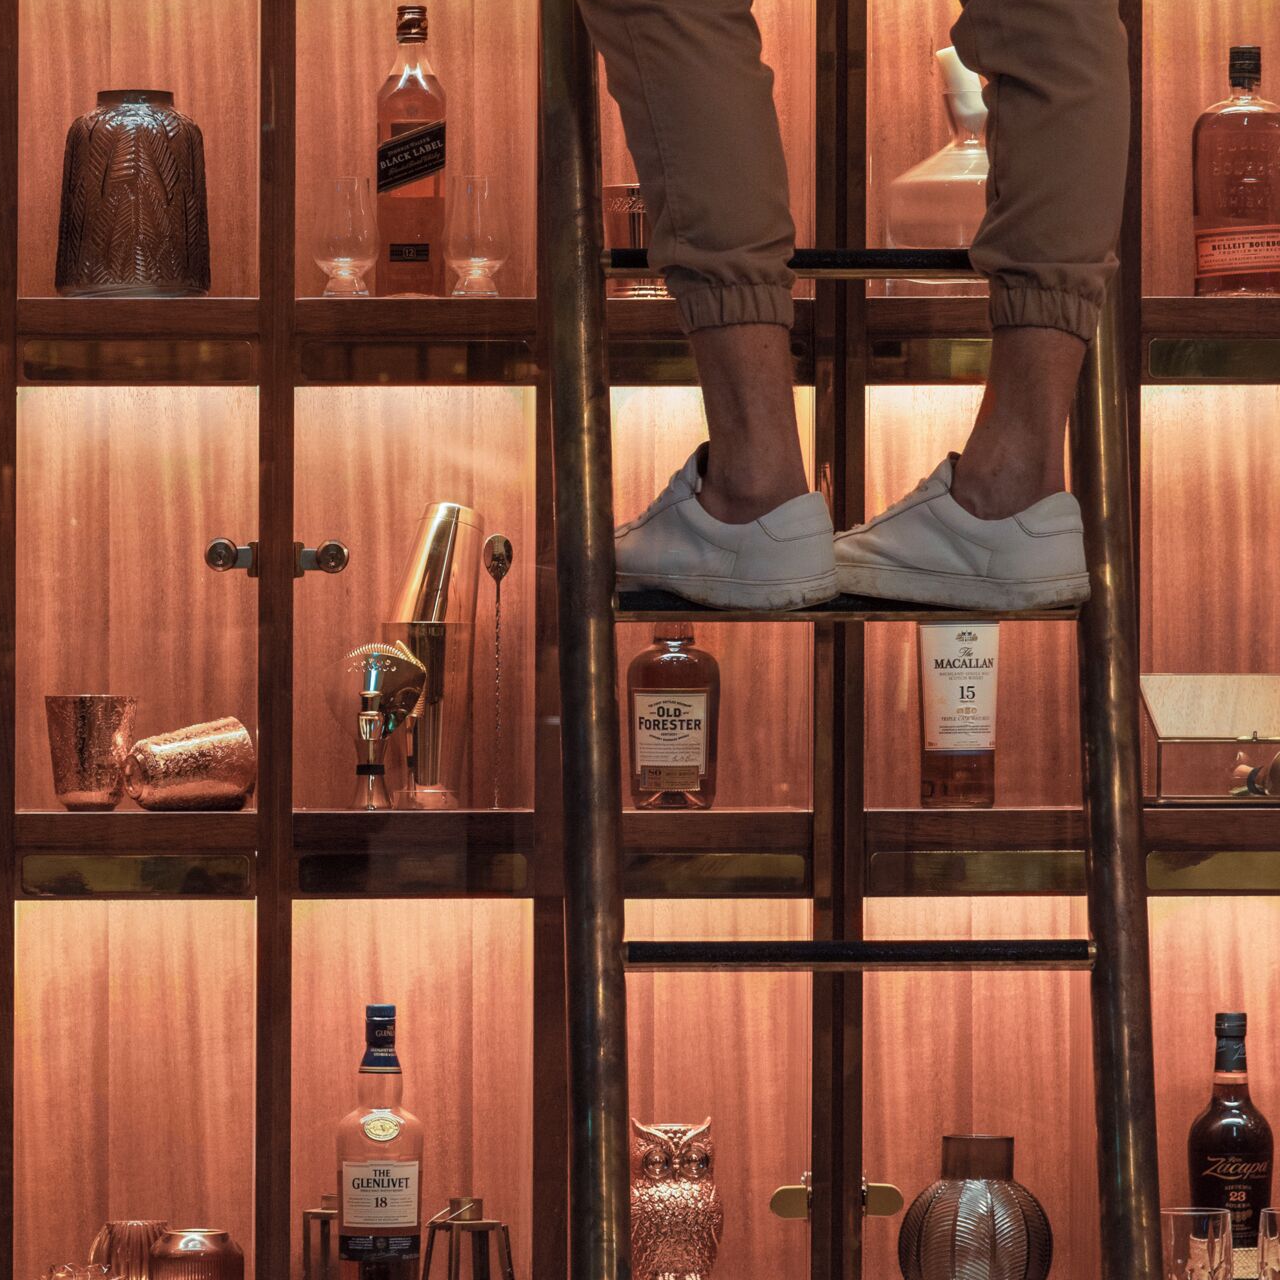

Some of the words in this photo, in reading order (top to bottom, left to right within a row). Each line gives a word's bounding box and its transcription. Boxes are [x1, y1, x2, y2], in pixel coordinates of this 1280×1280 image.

[380, 151, 412, 169] BLACK
[412, 140, 444, 157] LABEL
[1211, 242, 1246, 251] BULLEIT
[405, 248, 415, 258] 12
[958, 646, 973, 658] The
[933, 658, 994, 669] MACALLAN
[959, 685, 976, 700] 15
[656, 706, 682, 718] OLD
[638, 716, 702, 730] FORESTER
[372, 1168, 391, 1177] THE
[1201, 1156, 1268, 1180] Zacapa
[351, 1177, 410, 1190] GLENLIVET
[373, 1196, 388, 1208] 18
[1229, 1191, 1246, 1201] 23
